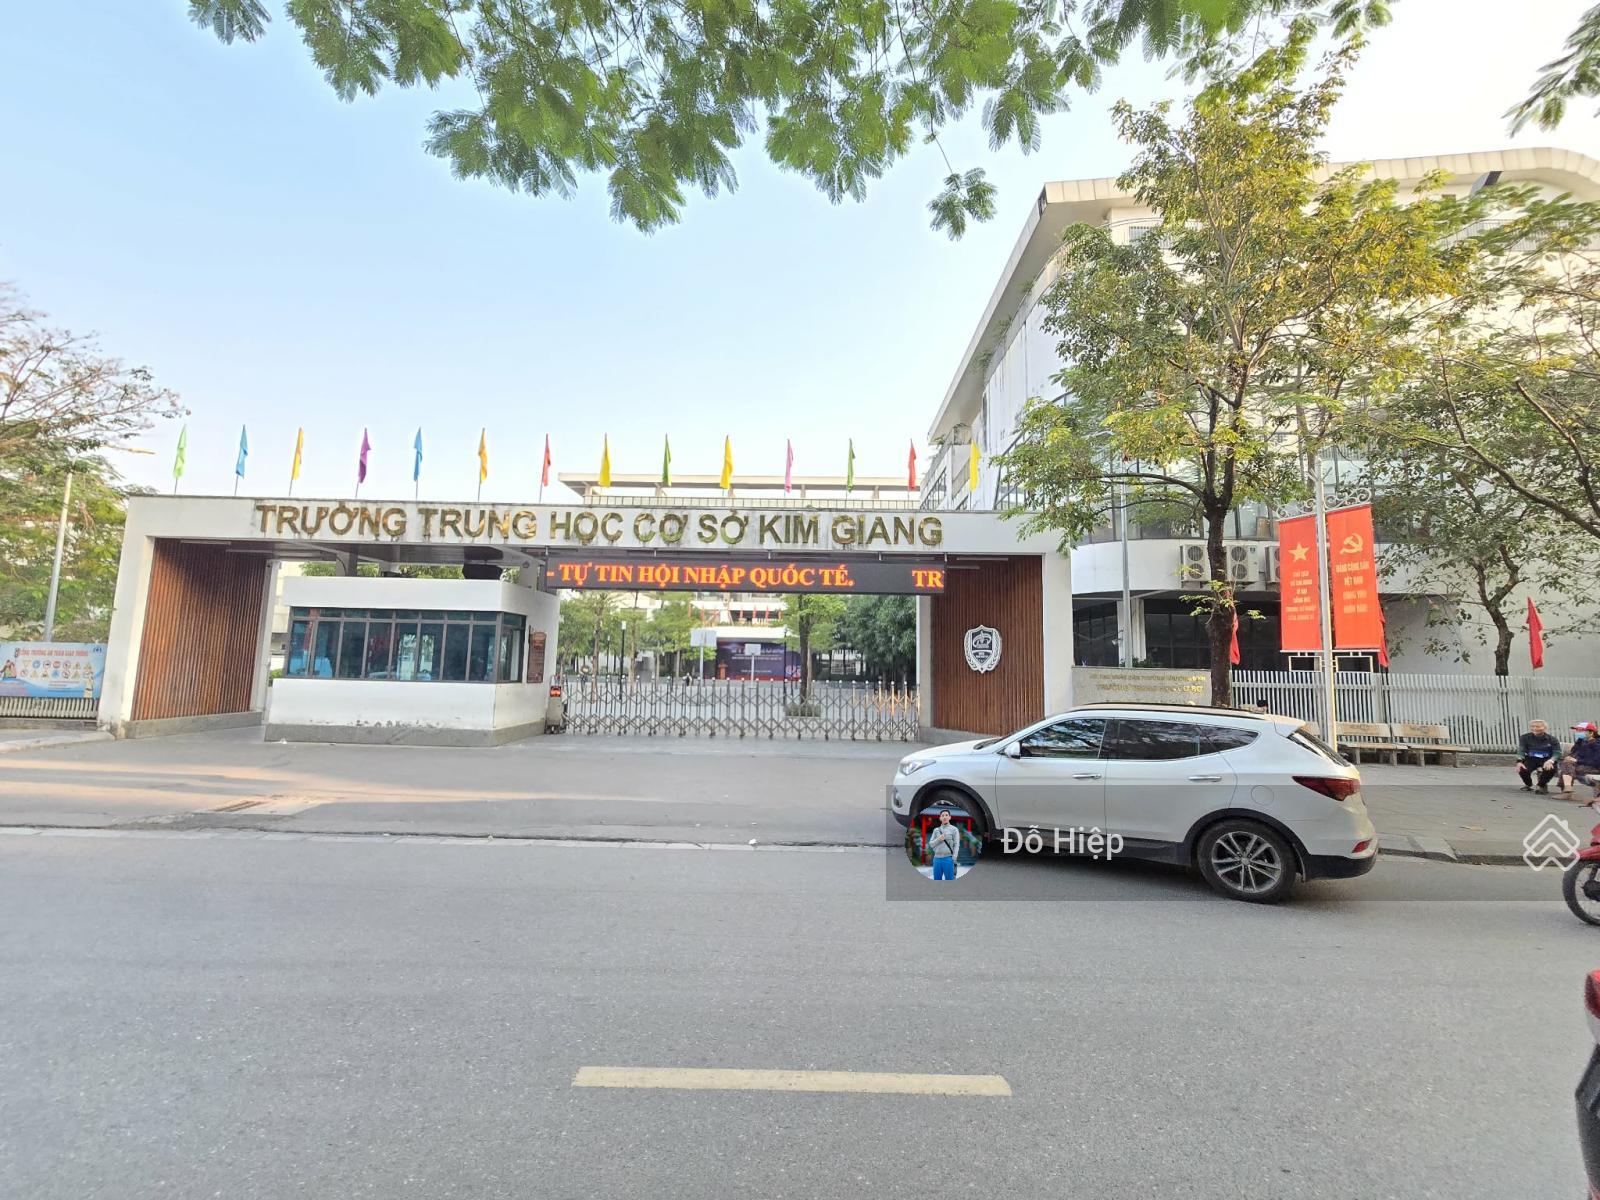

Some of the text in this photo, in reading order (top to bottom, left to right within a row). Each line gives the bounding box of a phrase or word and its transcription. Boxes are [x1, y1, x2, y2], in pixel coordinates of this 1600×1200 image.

[256, 502, 942, 545] TRƯỜNG TRUNG HỌC CƠ SỞ KIM GIANG
[559, 562, 592, 586] TỰ
[595, 564, 633, 582] TIN
[638, 564, 680, 587] HỘI
[684, 565, 745, 588] NHẬP
[750, 563, 815, 588] QUỐC
[819, 564, 855, 586] TẾ.
[912, 570, 945, 587] TR
